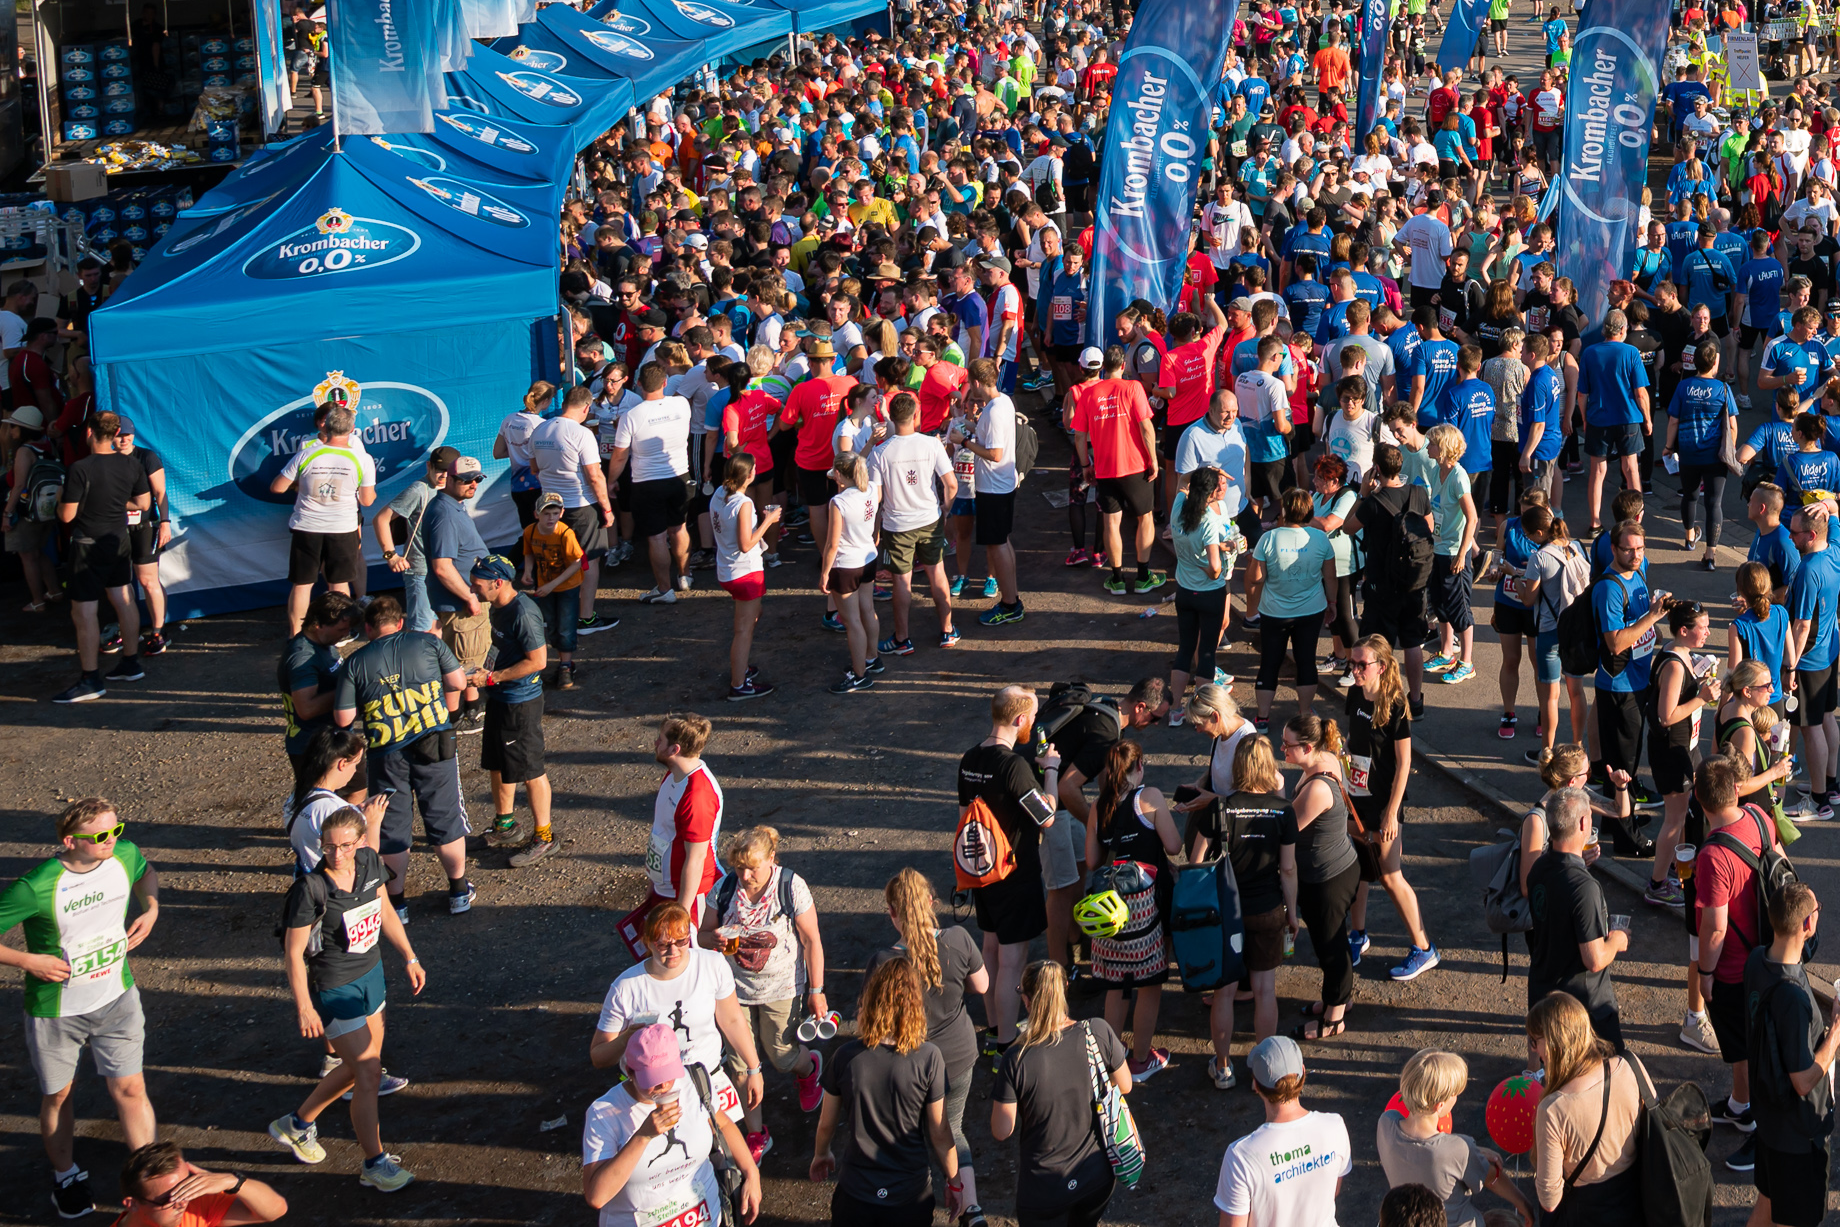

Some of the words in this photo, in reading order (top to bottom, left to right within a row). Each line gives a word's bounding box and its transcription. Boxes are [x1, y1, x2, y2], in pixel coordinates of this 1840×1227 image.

[1570, 48, 1617, 182] Krombacher
[1110, 71, 1167, 217] Krombacher
[279, 234, 389, 259] Krombacher
[1686, 386, 1713, 398] Victor's
[601, 443, 615, 454] 85
[1800, 461, 1828, 477] Victor's
[64, 891, 104, 913] Verbio
[74, 940, 126, 974] 6154
[90, 968, 111, 980] REWE
[1269, 1144, 1312, 1166] thoma
[1274, 1150, 1337, 1184] architekten
[647, 1200, 678, 1218] schnelle
